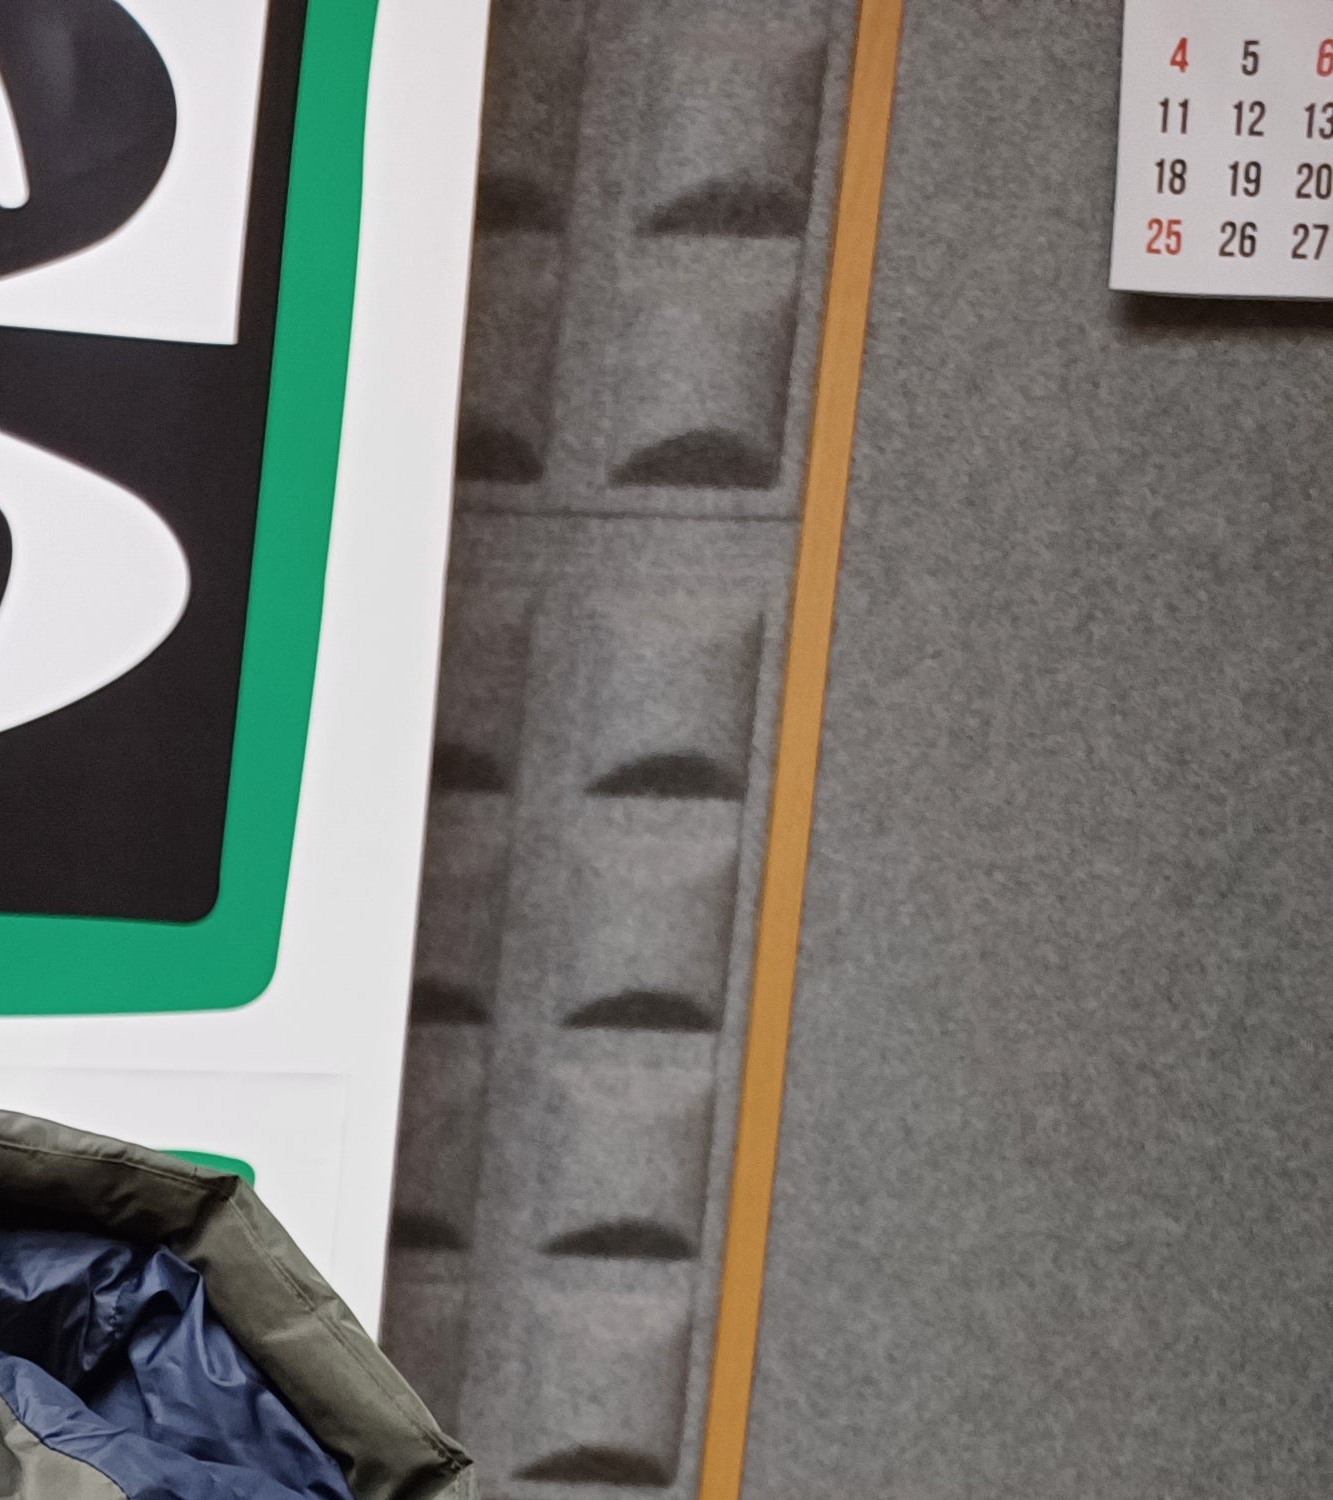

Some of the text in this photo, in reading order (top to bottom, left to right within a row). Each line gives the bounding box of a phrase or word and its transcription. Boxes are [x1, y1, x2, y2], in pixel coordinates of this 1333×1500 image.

[1170, 37, 1333, 77] 4 5 6
[1158, 97, 1333, 140] 11 12 13
[1155, 158, 1333, 200] 18 19 20
[1145, 218, 1330, 261] 25 26 27
